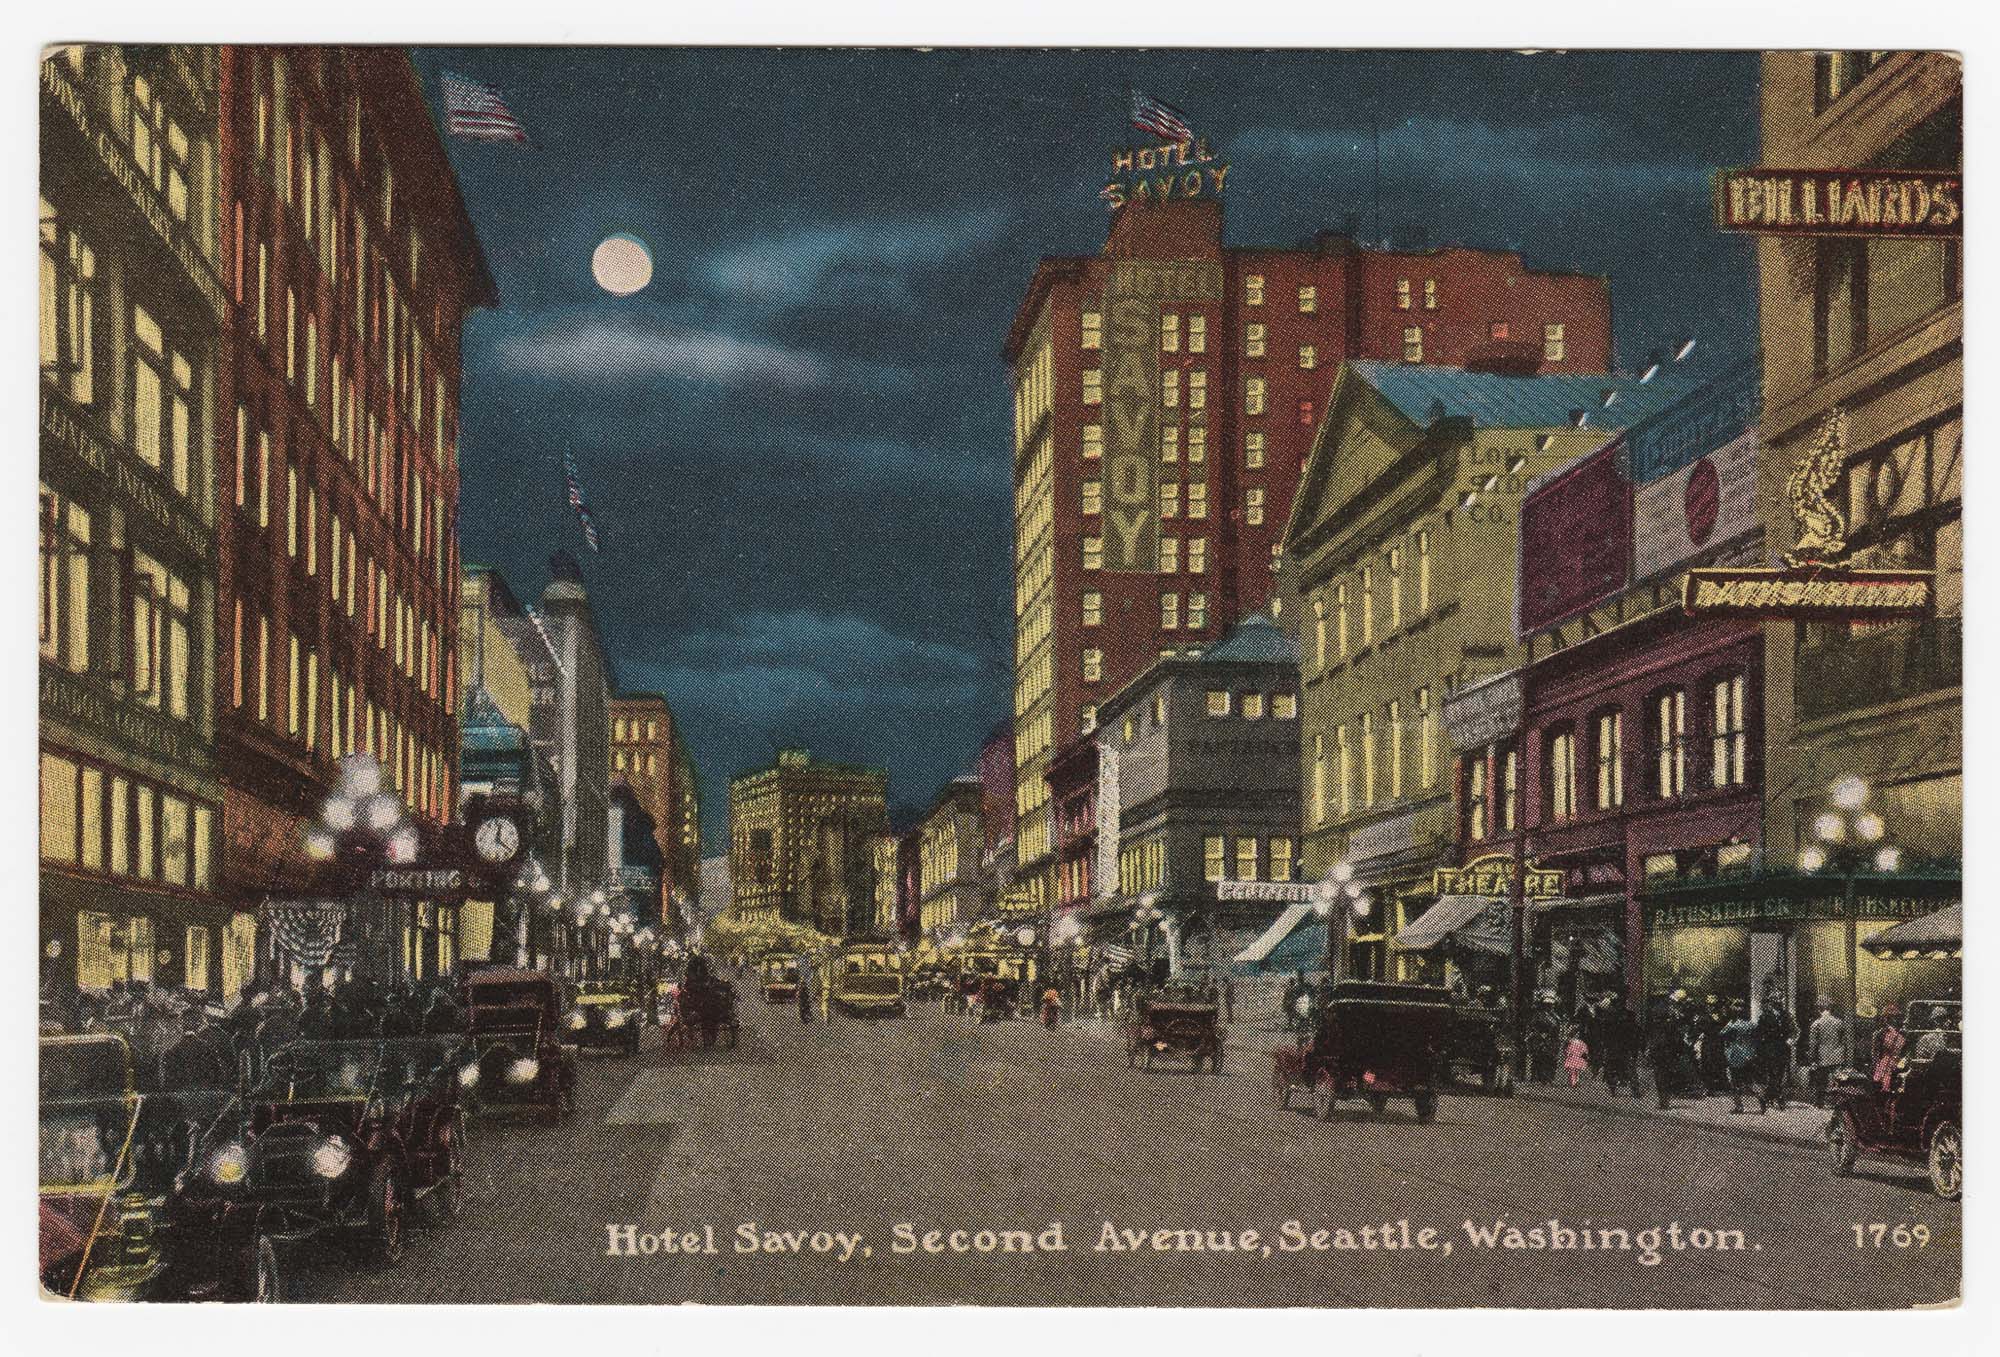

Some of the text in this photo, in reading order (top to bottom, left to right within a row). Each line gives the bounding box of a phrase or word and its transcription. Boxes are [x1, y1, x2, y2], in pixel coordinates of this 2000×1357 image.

[1110, 138, 1214, 175] HOTEL
[1099, 162, 1232, 208] SAVOY
[1729, 177, 1960, 225] BILLIARDS
[1116, 267, 1216, 297] HOTEL
[1107, 297, 1155, 568] SAVOY
[1470, 502, 1513, 525] CO.
[1443, 872, 1560, 895] THEARE
